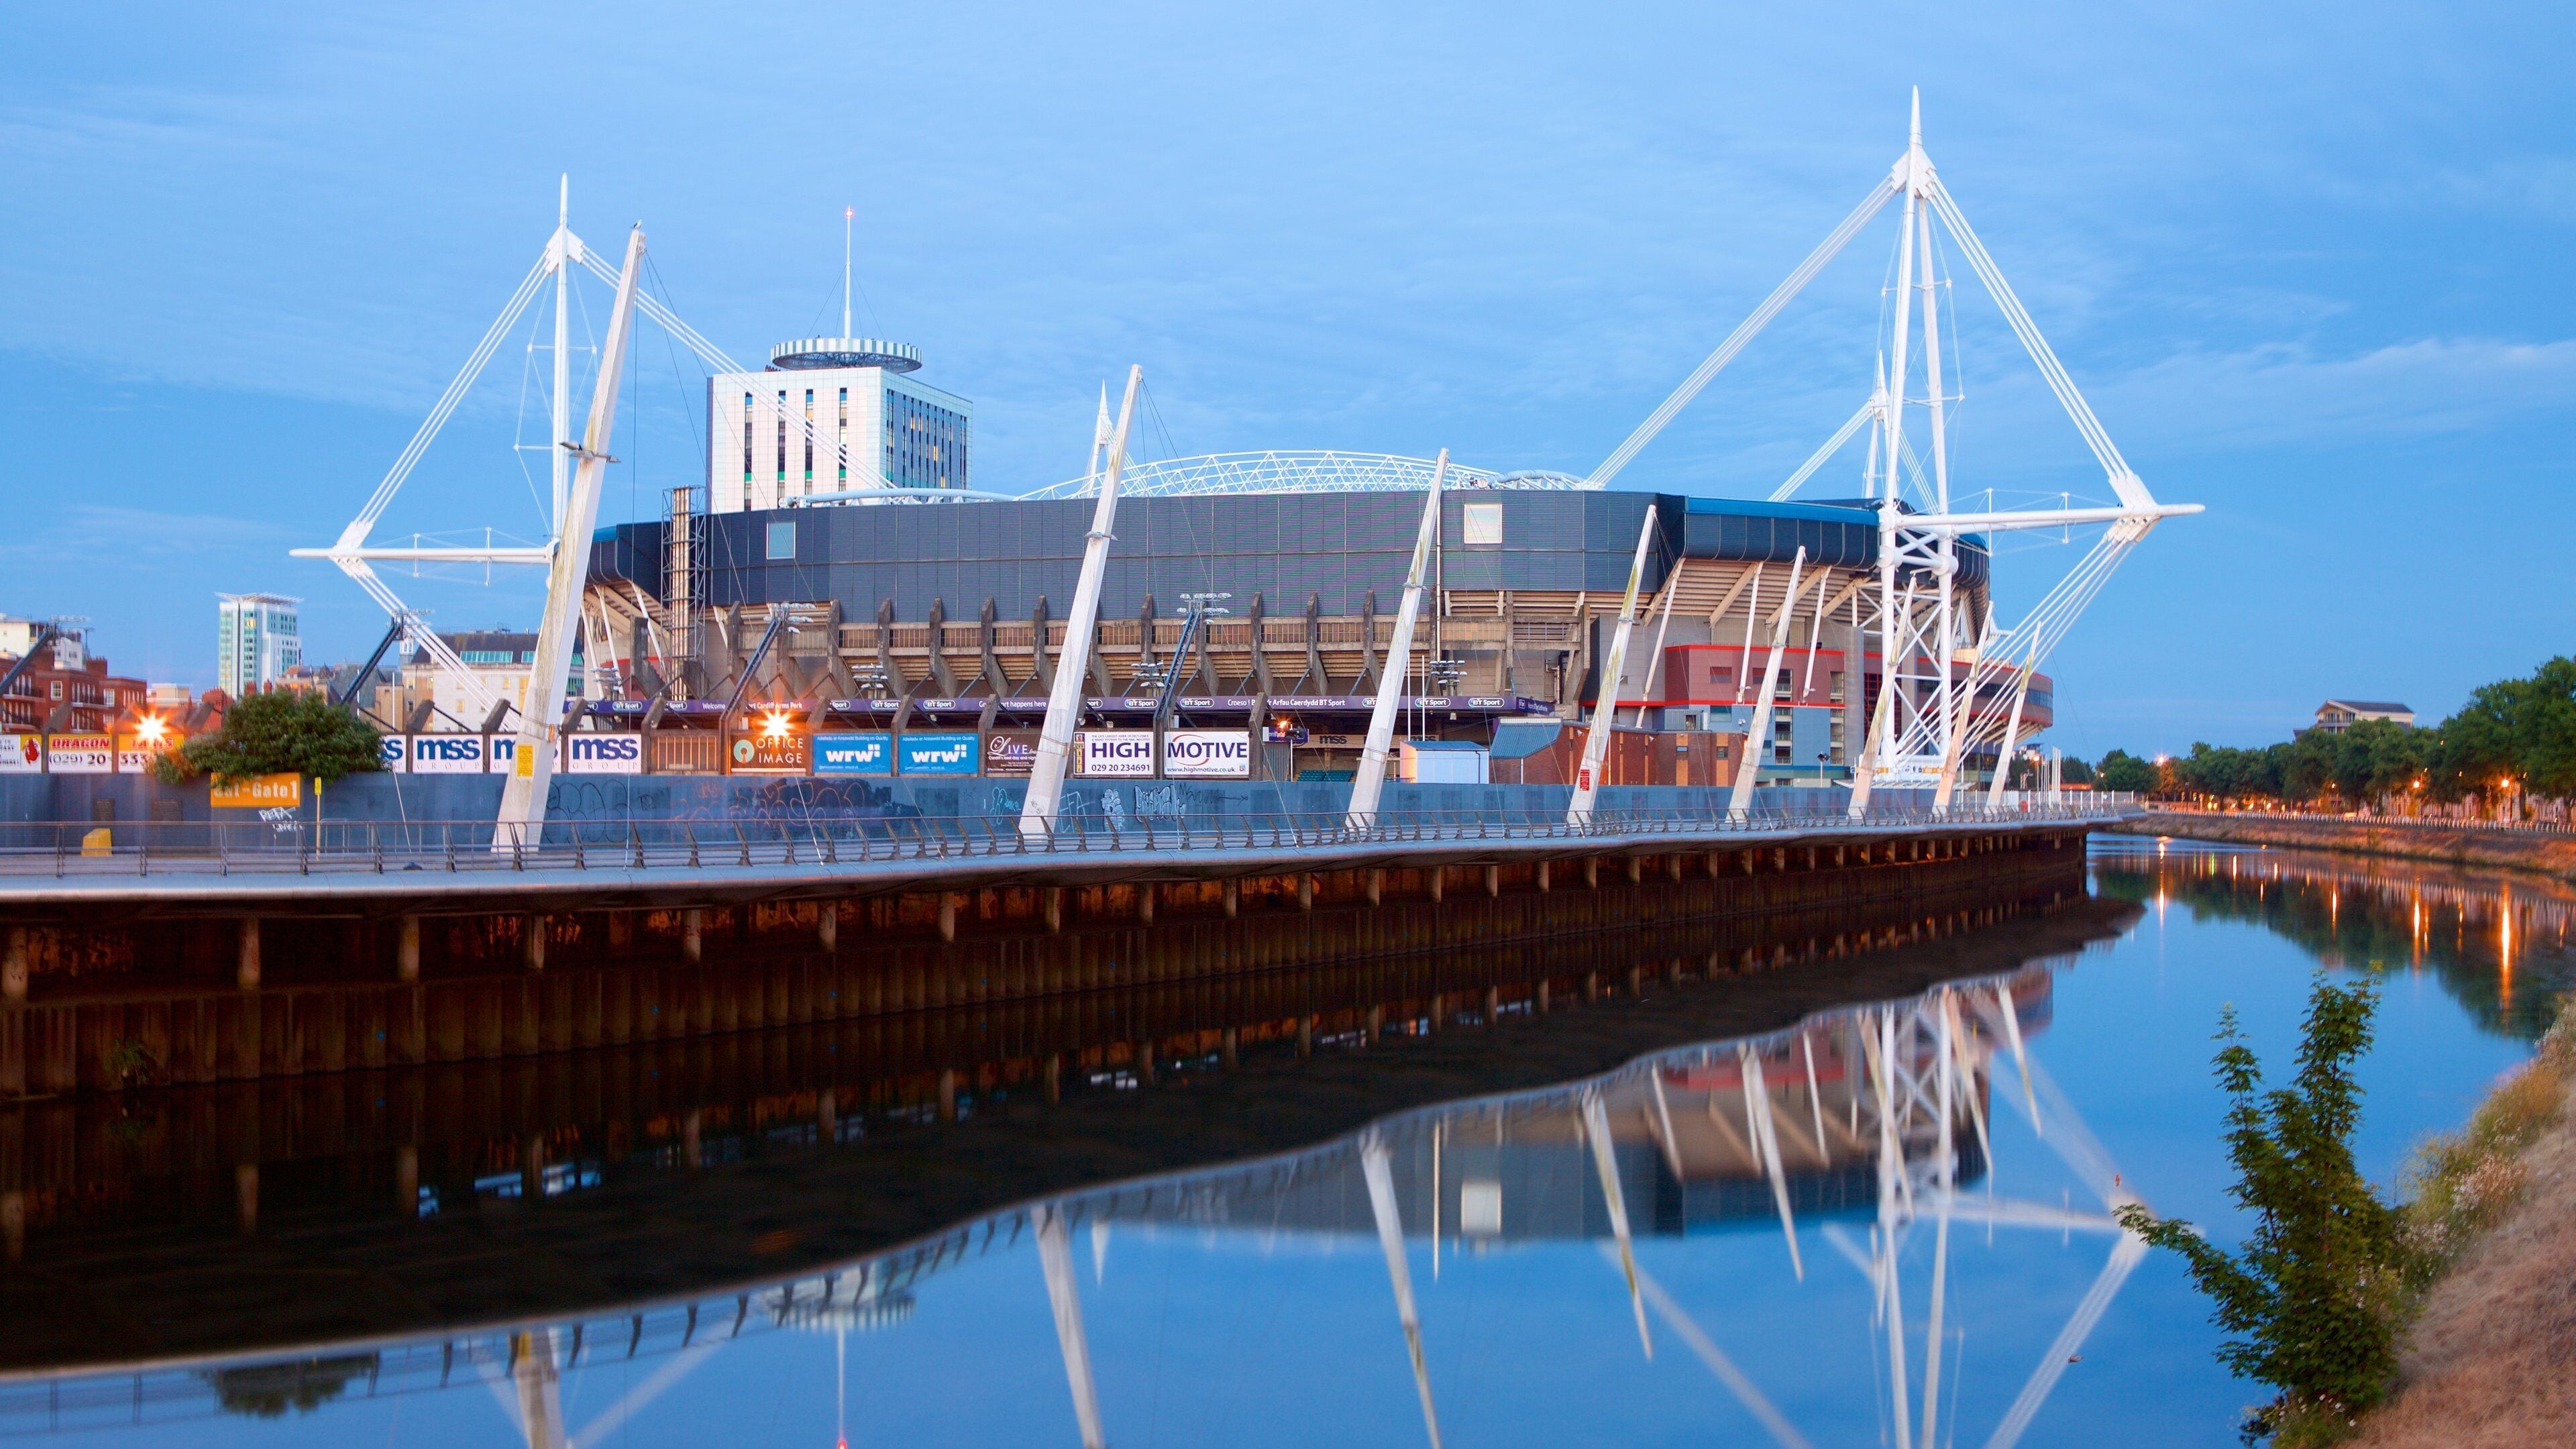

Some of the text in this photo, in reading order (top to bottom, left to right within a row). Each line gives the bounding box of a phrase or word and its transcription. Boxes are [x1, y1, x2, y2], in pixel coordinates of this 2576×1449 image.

[1010, 700, 1033, 708] happens
[52, 738, 109, 748] DRAGON
[756, 737, 804, 749] OFFICE
[1091, 742, 1150, 758] HIGH
[1167, 742, 1248, 758] MOTIVE
[49, 753, 83, 764] (029)
[759, 752, 802, 764] IMAGE
[417, 761, 480, 770] GROUP
[572, 761, 637, 769] GROUP
